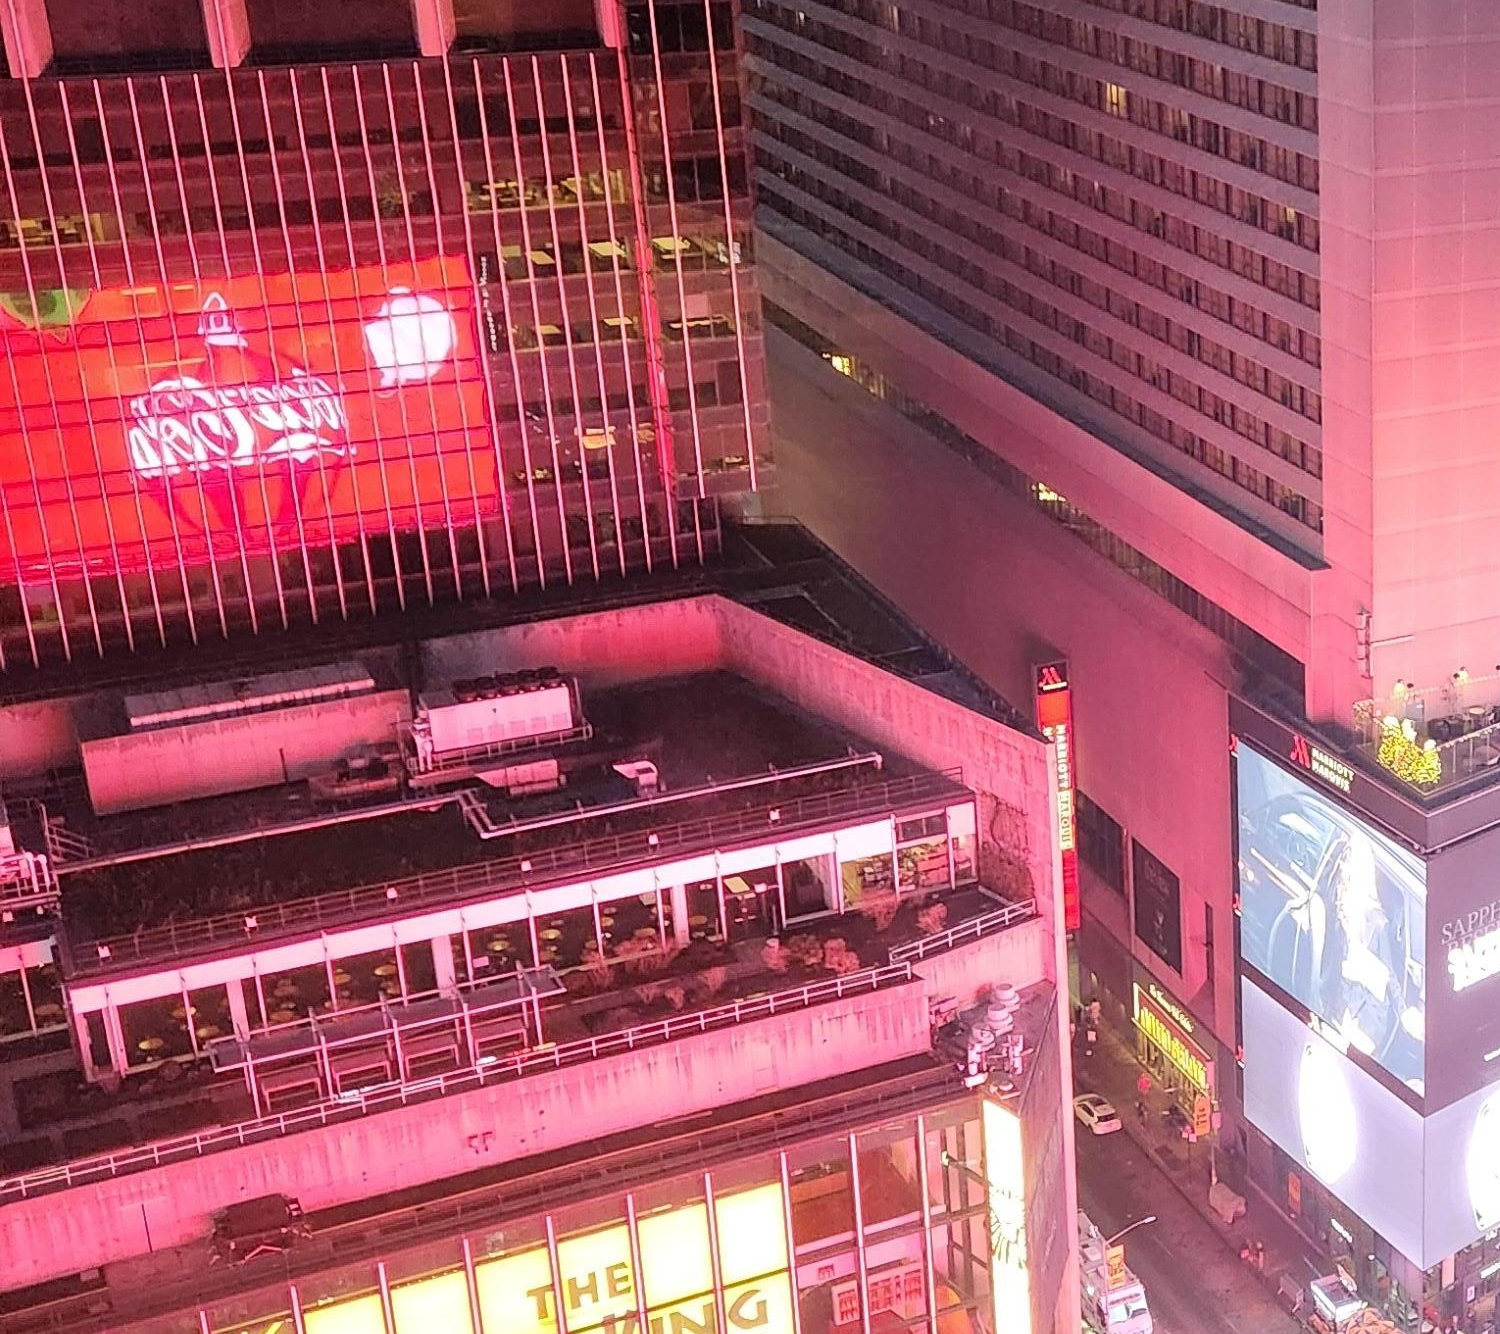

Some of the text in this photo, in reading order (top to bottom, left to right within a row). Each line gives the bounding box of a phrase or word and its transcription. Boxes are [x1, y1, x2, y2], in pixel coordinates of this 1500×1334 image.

[1056, 724, 1070, 789] MARRIOTT
[1311, 747, 1356, 782] MARRIOTT
[526, 1261, 632, 1321] THE
